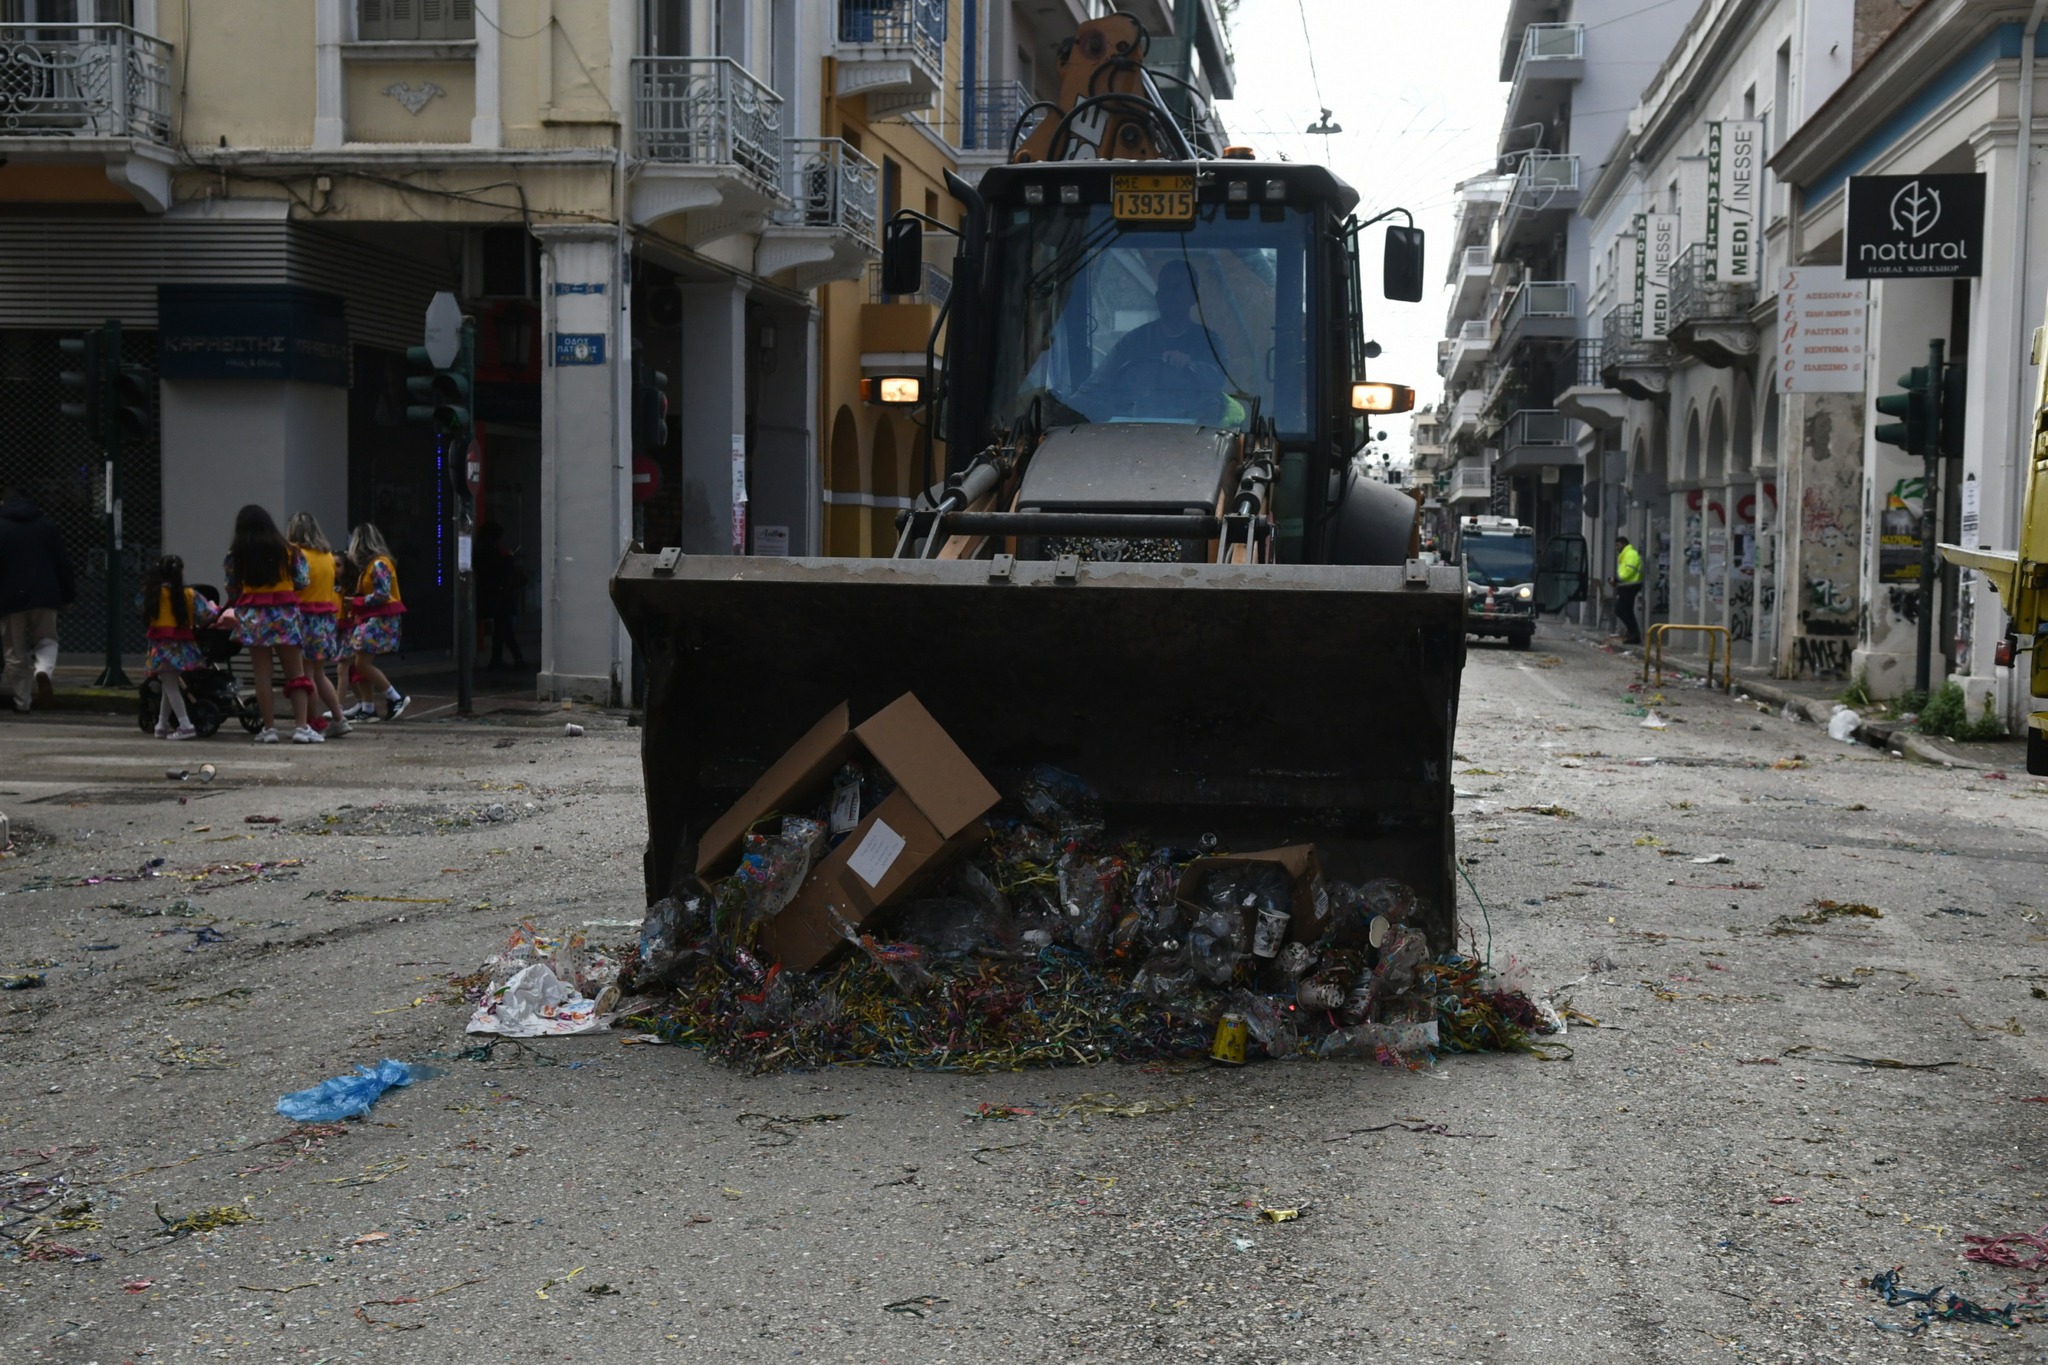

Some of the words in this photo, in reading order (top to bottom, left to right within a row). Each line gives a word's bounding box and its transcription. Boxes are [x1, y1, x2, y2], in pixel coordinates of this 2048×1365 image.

[1118, 194, 1191, 216] 139315
[1860, 240, 1967, 260] natural
[1804, 328, 1849, 336] ΡΑΠΤΙΚΗ
[165, 336, 286, 352] ΚΑΡΑΒΙΤΗΣ
[1804, 346, 1850, 354] ΚΕΝΤΗΜΑ
